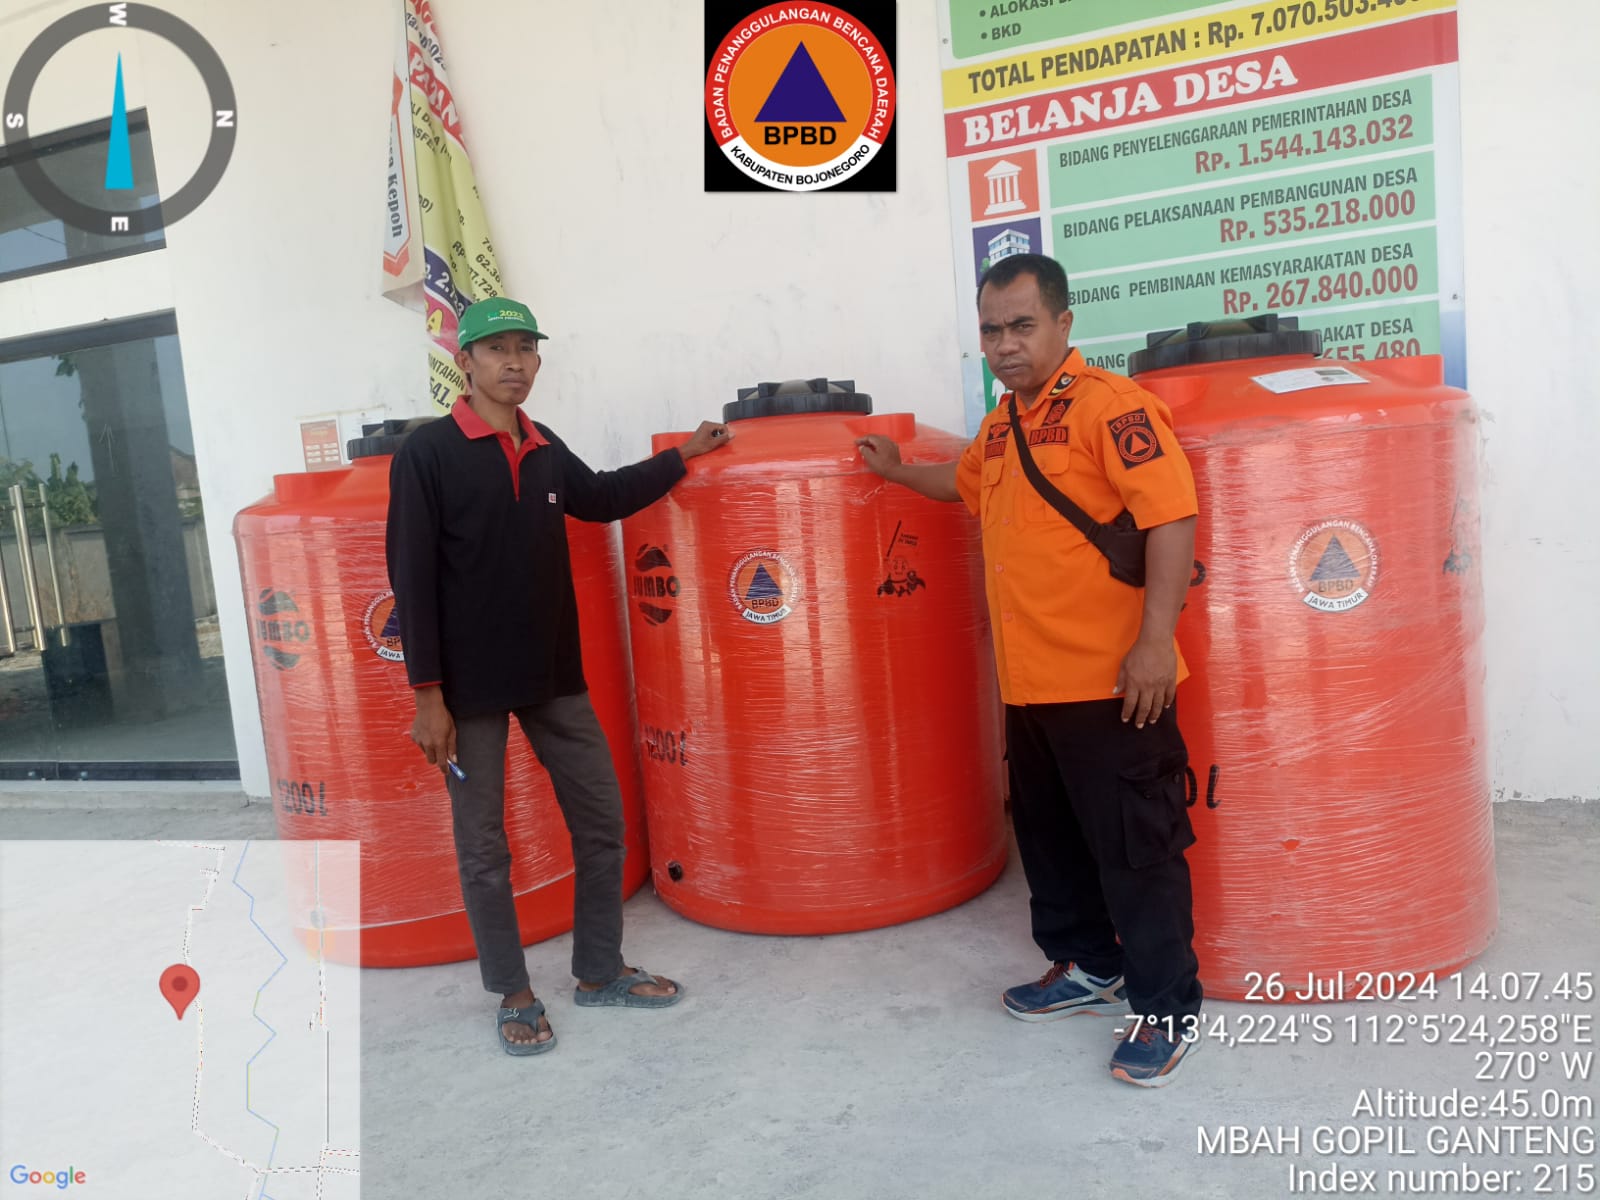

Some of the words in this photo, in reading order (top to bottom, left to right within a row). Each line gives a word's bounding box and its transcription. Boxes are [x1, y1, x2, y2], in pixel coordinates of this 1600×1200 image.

[968, 61, 1034, 94] TOTAL
[1041, 29, 1187, 79] PENDAPATAN
[1208, 21, 1244, 47] Rp.
[991, 23, 1021, 40] BKD
[962, 81, 1162, 147] BELANJA
[1173, 55, 1299, 107] DESA
[1060, 145, 1109, 168] BIDANG
[1113, 120, 1247, 158] PENYELENGGARAAN
[1252, 97, 1367, 133] PEMERINTAHAN
[1372, 89, 1412, 111] DESA
[1195, 150, 1231, 174] Rp.
[1238, 114, 1414, 166] 1.544.143.032
[1063, 216, 1119, 239] BIDANG
[1124, 197, 1235, 229] PELAKSANAAN
[1240, 175, 1367, 210] PEMBANGUNAN
[1373, 167, 1418, 189] DESA
[1220, 218, 1256, 243] Rp.
[1263, 189, 1416, 236] 535.218.000
[1068, 284, 1120, 306] BIDANG
[1129, 271, 1215, 297] PEMBINAAN
[1220, 249, 1366, 284] KEMASYARAKATAN
[1372, 242, 1413, 263] DESA
[1224, 289, 1258, 314] Rp.
[1266, 264, 1418, 309] 267.840.000
[1371, 317, 1413, 338] DESA
[751, 597, 779, 609] BPBD
[1308, 595, 1335, 609] JAWA
[1335, 591, 1364, 608] TIMUR
[1318, 580, 1354, 592] BPBD
[746, 611, 766, 621] JAWA
[767, 608, 788, 621] TIMUR
